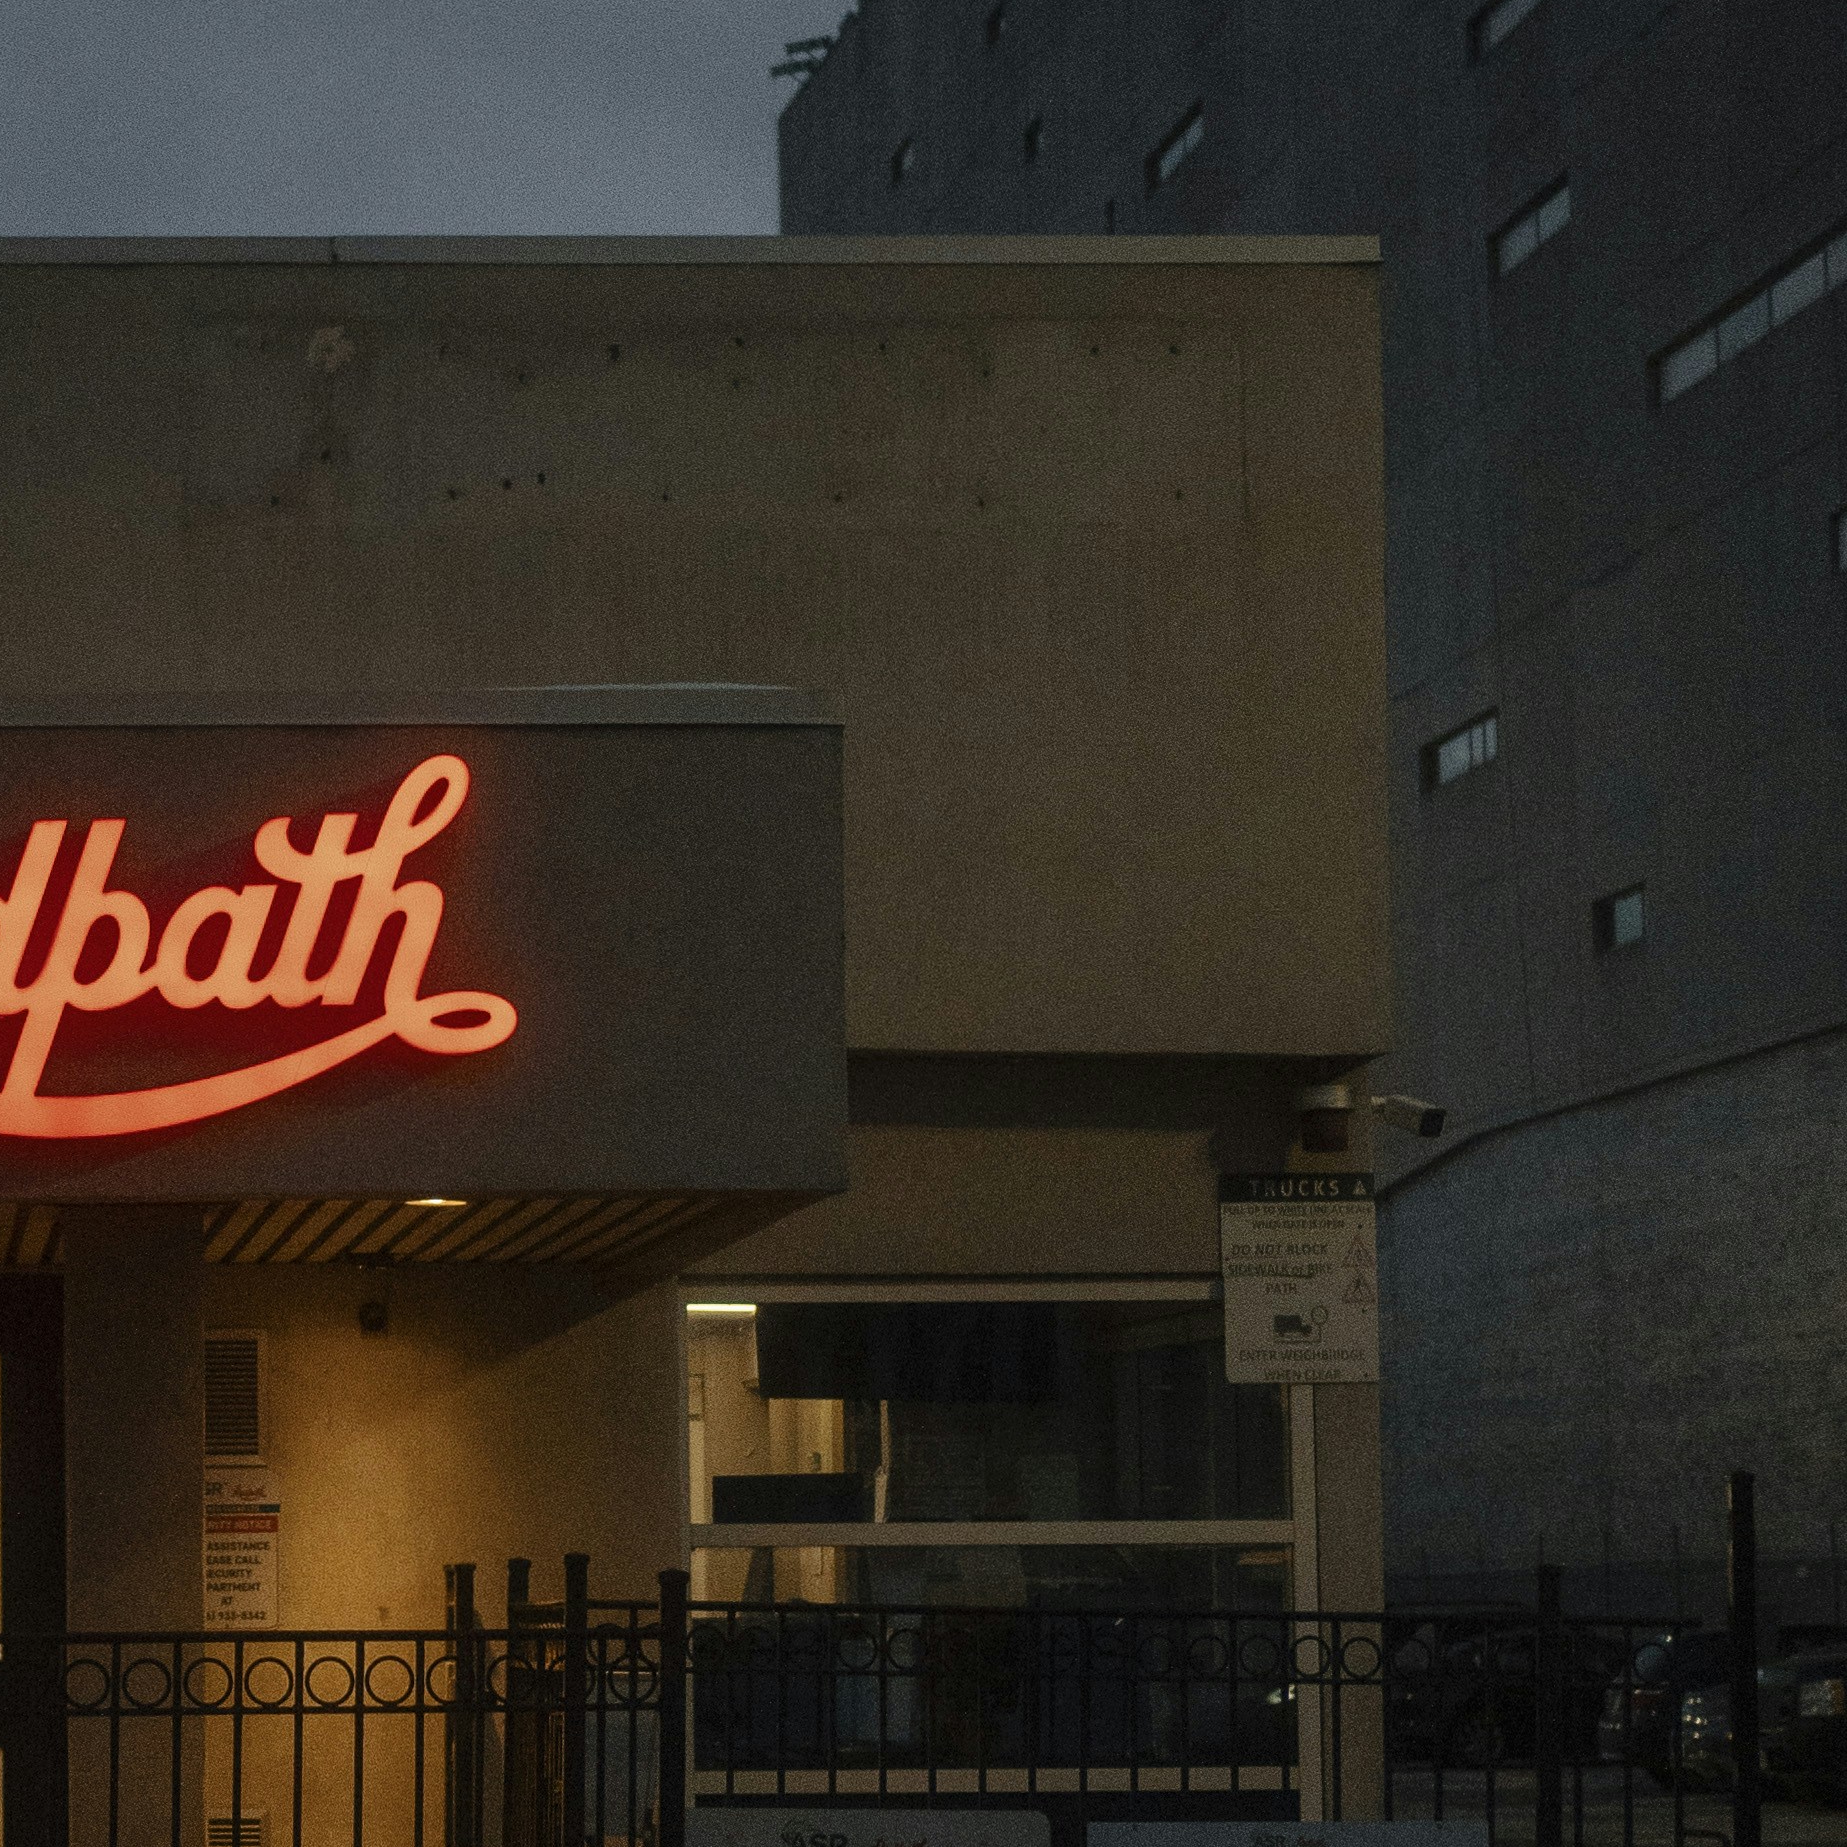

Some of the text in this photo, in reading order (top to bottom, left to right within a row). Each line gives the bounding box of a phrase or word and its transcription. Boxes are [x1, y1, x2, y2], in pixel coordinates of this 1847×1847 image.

[1249, 1179, 1340, 1197] TRUCKS
[1231, 1243, 1328, 1256] DO NOT BLOCK
[1227, 1263, 1289, 1276] SIDEWALK
[1265, 1282, 1298, 1294] PATH
[1239, 1349, 1276, 1362] ENTER
[207, 1540, 270, 1551] ASSISTANCE
[206, 1554, 262, 1565] EASE CALL
[206, 1568, 253, 1579] ECURITY
[206, 1582, 261, 1592] PARTMENT
